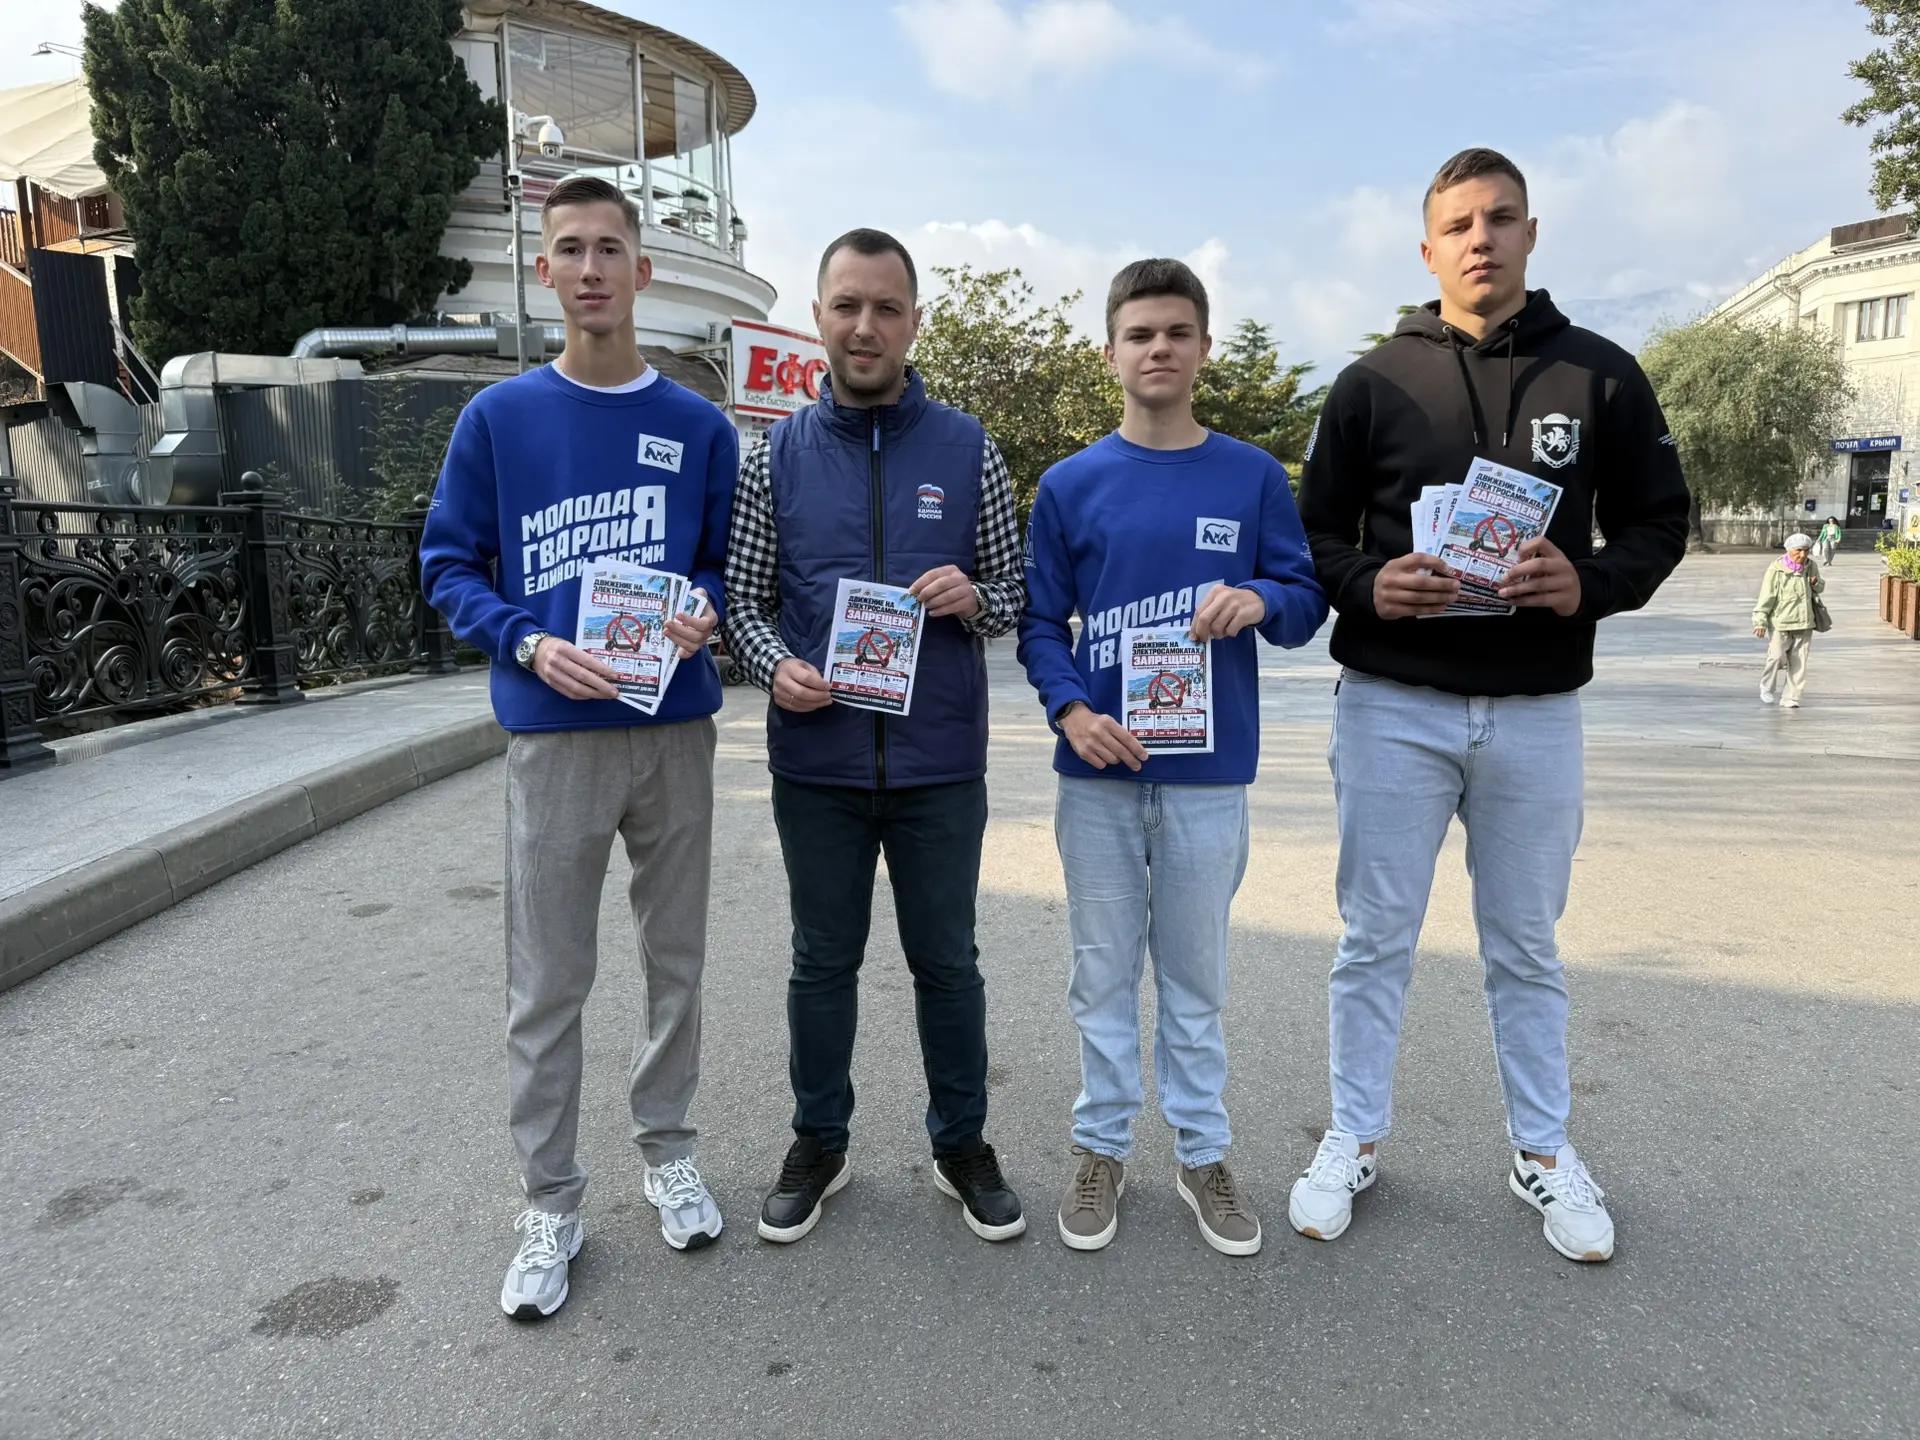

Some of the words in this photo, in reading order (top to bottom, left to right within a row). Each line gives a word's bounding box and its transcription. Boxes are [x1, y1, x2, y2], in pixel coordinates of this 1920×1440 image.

[1835, 440, 1858, 449] ПОЧТА
[1870, 438, 1896, 448] КРЫМА
[1476, 473, 1518, 492] ДВИЖЕНИЕ
[1517, 487, 1527, 495] НА
[1473, 480, 1546, 509] ЭЛЕКТРОСАМОКАТАХ
[1470, 488, 1543, 521] ЗАПРЕЩЕНО
[593, 579, 632, 590] ДВИЖЕНИЕ
[593, 585, 663, 599] ЭЛЕКТРОСАМОКАТАХ
[593, 593, 663, 610] ЗАПРЕЩЕНО
[848, 595, 884, 606] ДВИЖЕНИЕ
[847, 602, 914, 618] ЭЛЕКТРОСАМОКАТАХ
[846, 610, 913, 627] ЗАПРЕЩЕНО
[1132, 647, 1200, 655] ЭЛЕКТРОСАМОКАТАХ
[1133, 655, 1200, 666] ЗАПРЕЩЕНО
